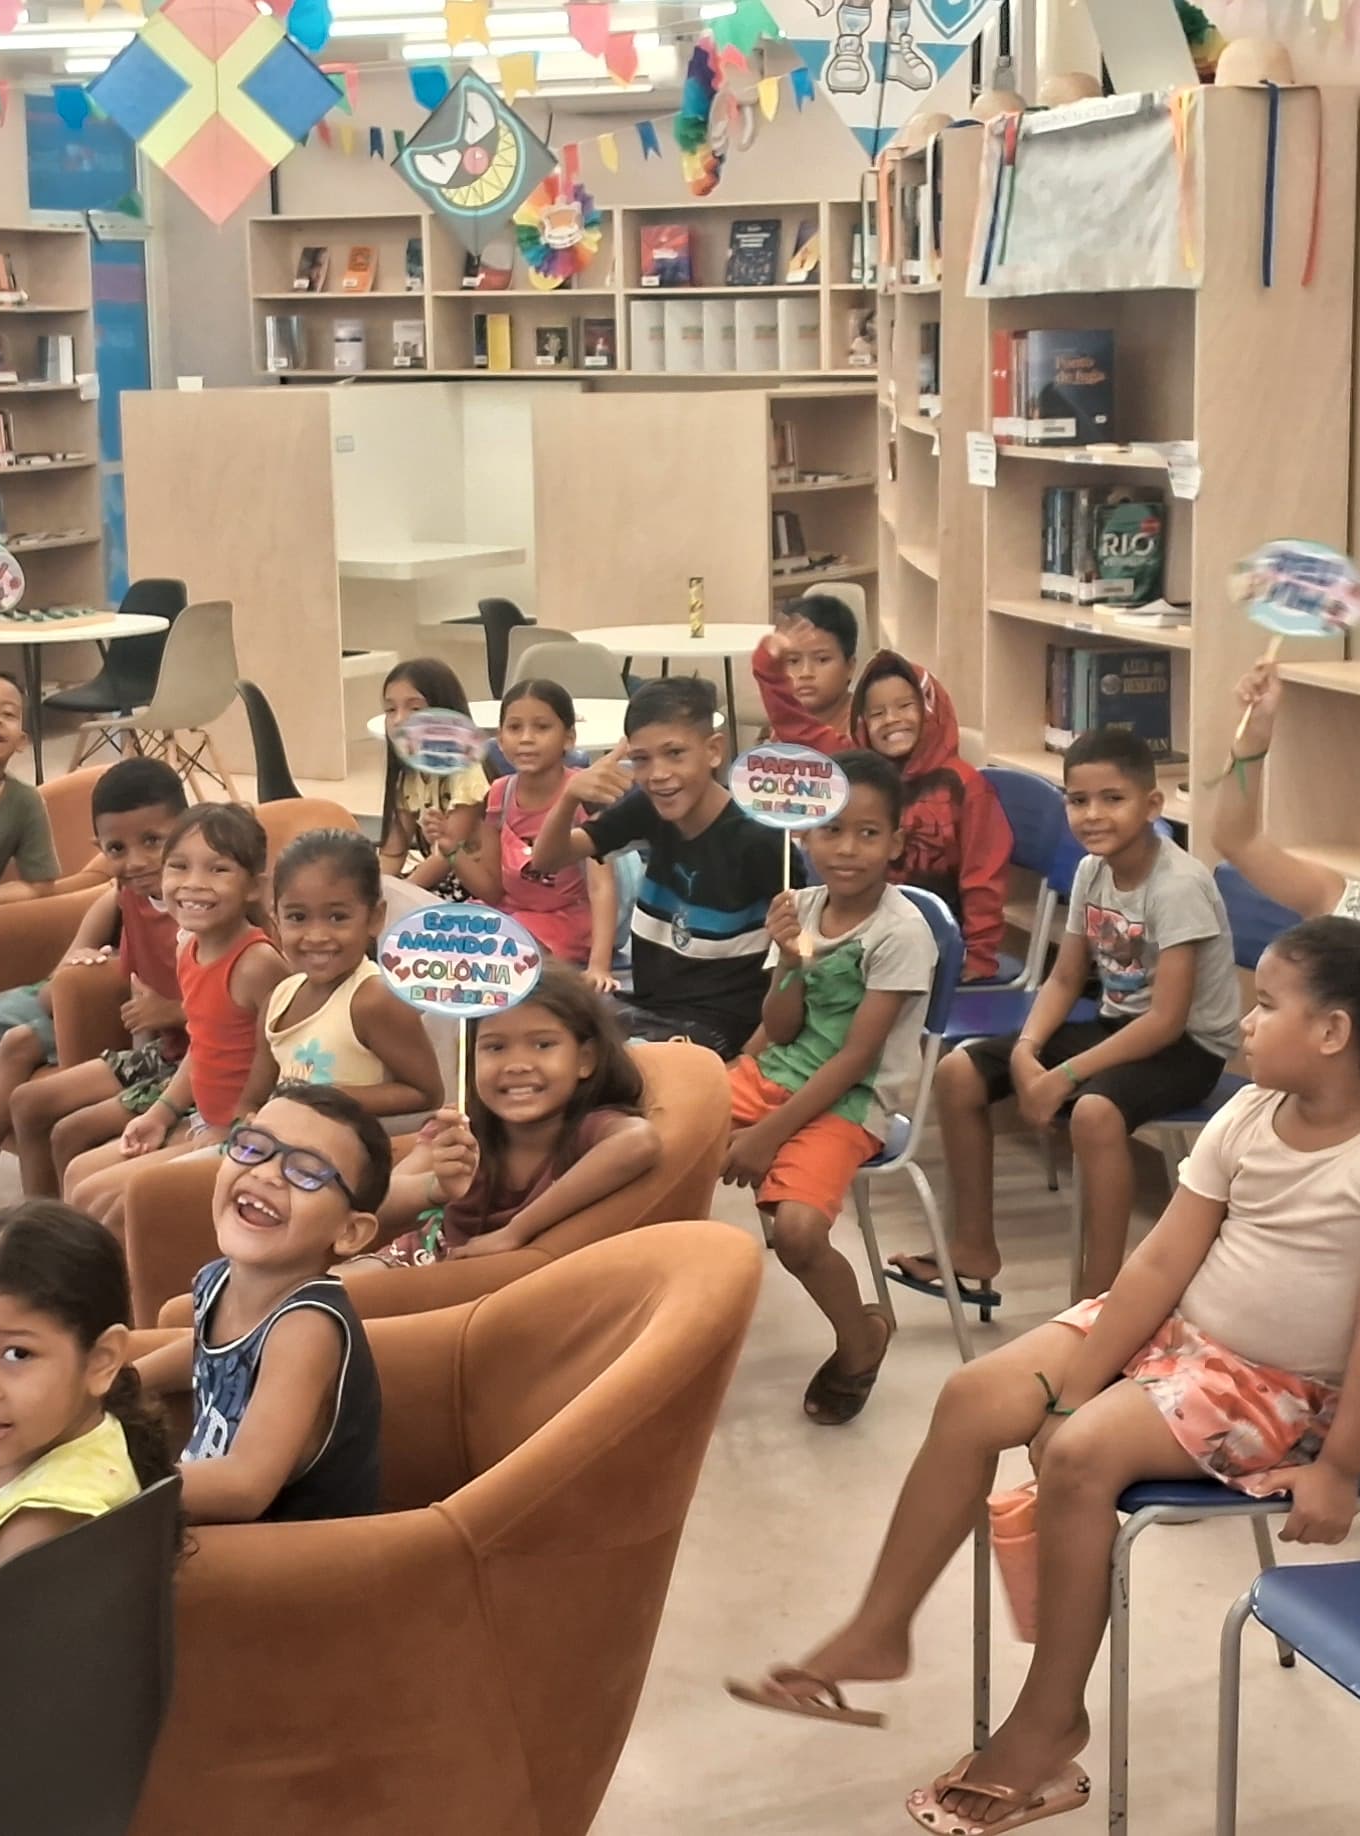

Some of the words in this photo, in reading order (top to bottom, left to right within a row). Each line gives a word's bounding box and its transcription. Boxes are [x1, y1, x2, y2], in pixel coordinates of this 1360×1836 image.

[1100, 532, 1156, 557] RIO
[747, 754, 833, 779] PARTIU
[749, 775, 832, 800] COLÔNIA
[423, 911, 502, 935] ESTOU
[397, 930, 498, 956] AMANDO
[501, 936, 518, 957] A
[411, 957, 511, 986] COLÔNIA
[410, 984, 438, 1001] DE
[441, 983, 509, 1007] FÉRIAS
